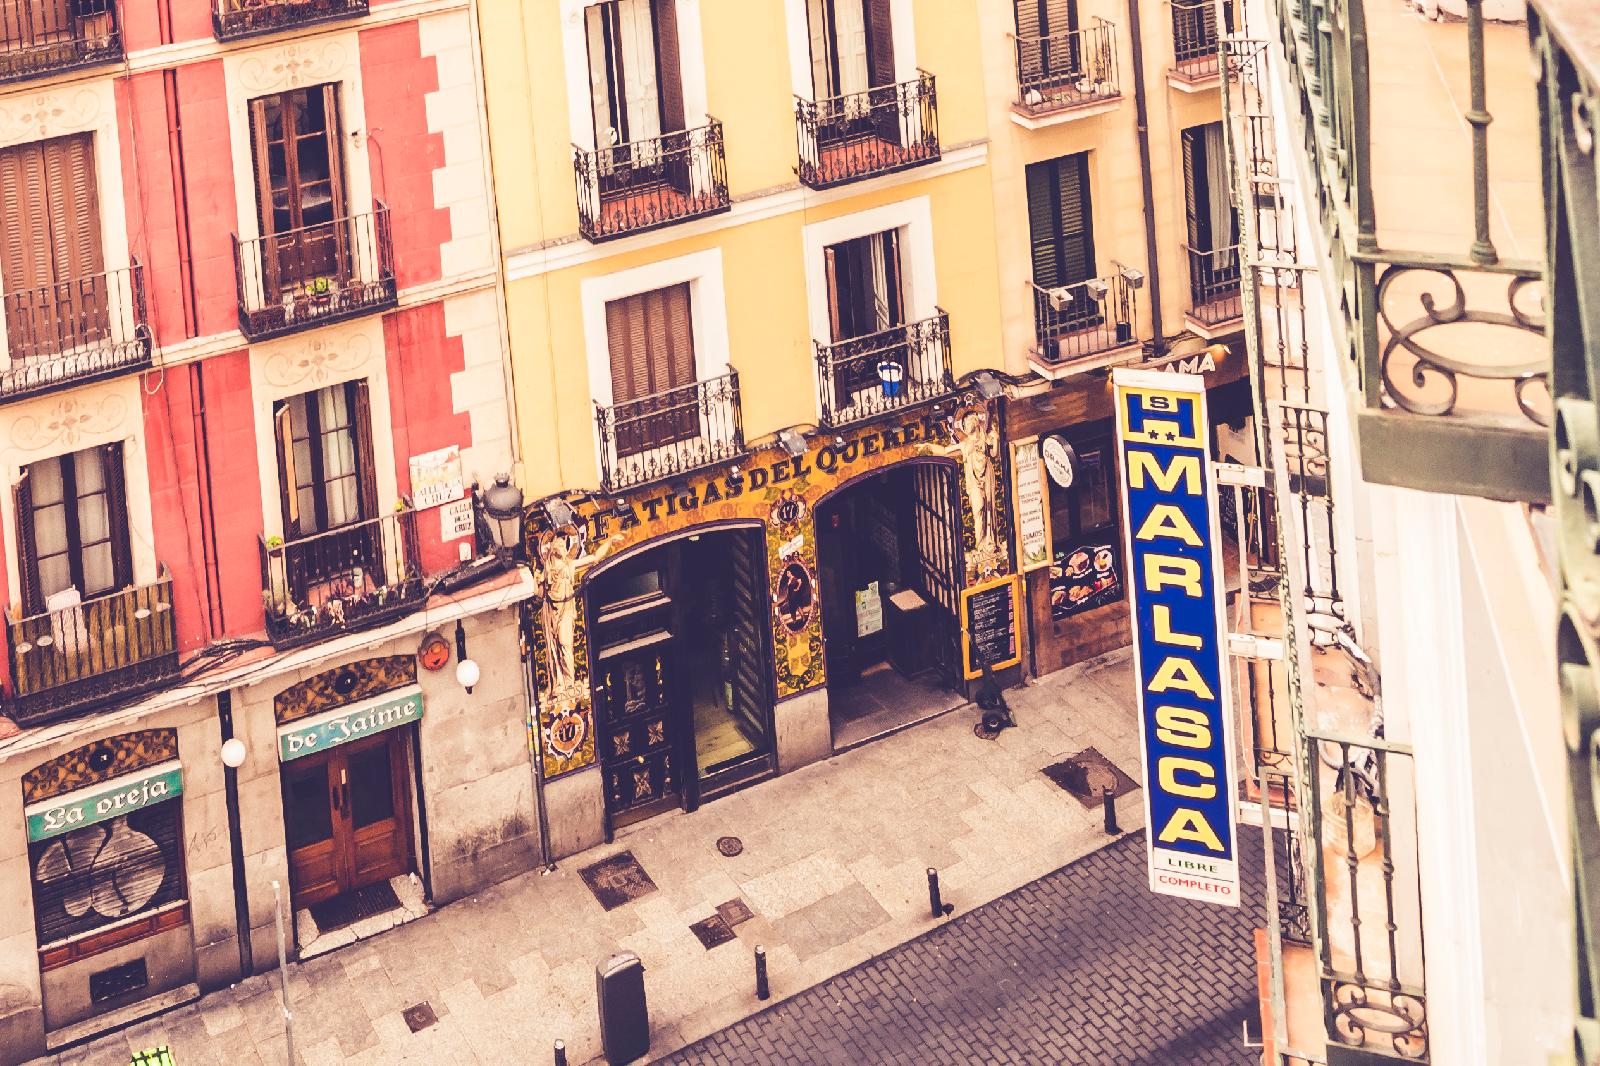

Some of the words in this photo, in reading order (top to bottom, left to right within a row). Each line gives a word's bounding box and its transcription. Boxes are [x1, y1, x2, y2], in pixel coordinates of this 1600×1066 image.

[1149, 396, 1170, 409] S
[1126, 393, 1195, 439] H
[587, 474, 744, 542] FATIGAS
[748, 455, 812, 492] DEL
[816, 413, 949, 476] QUERER
[424, 488, 452, 505] CRUZ
[449, 501, 472, 515] CALLE
[782, 505, 794, 519] 17
[454, 521, 471, 533] CRUZ
[1127, 449, 1225, 852] MARLASCA
[328, 700, 416, 743] Jaime
[43, 807, 85, 832] La
[96, 780, 169, 814] oreja
[1168, 858, 1218, 873] LIBRE
[1159, 875, 1231, 895] COMPLETO
